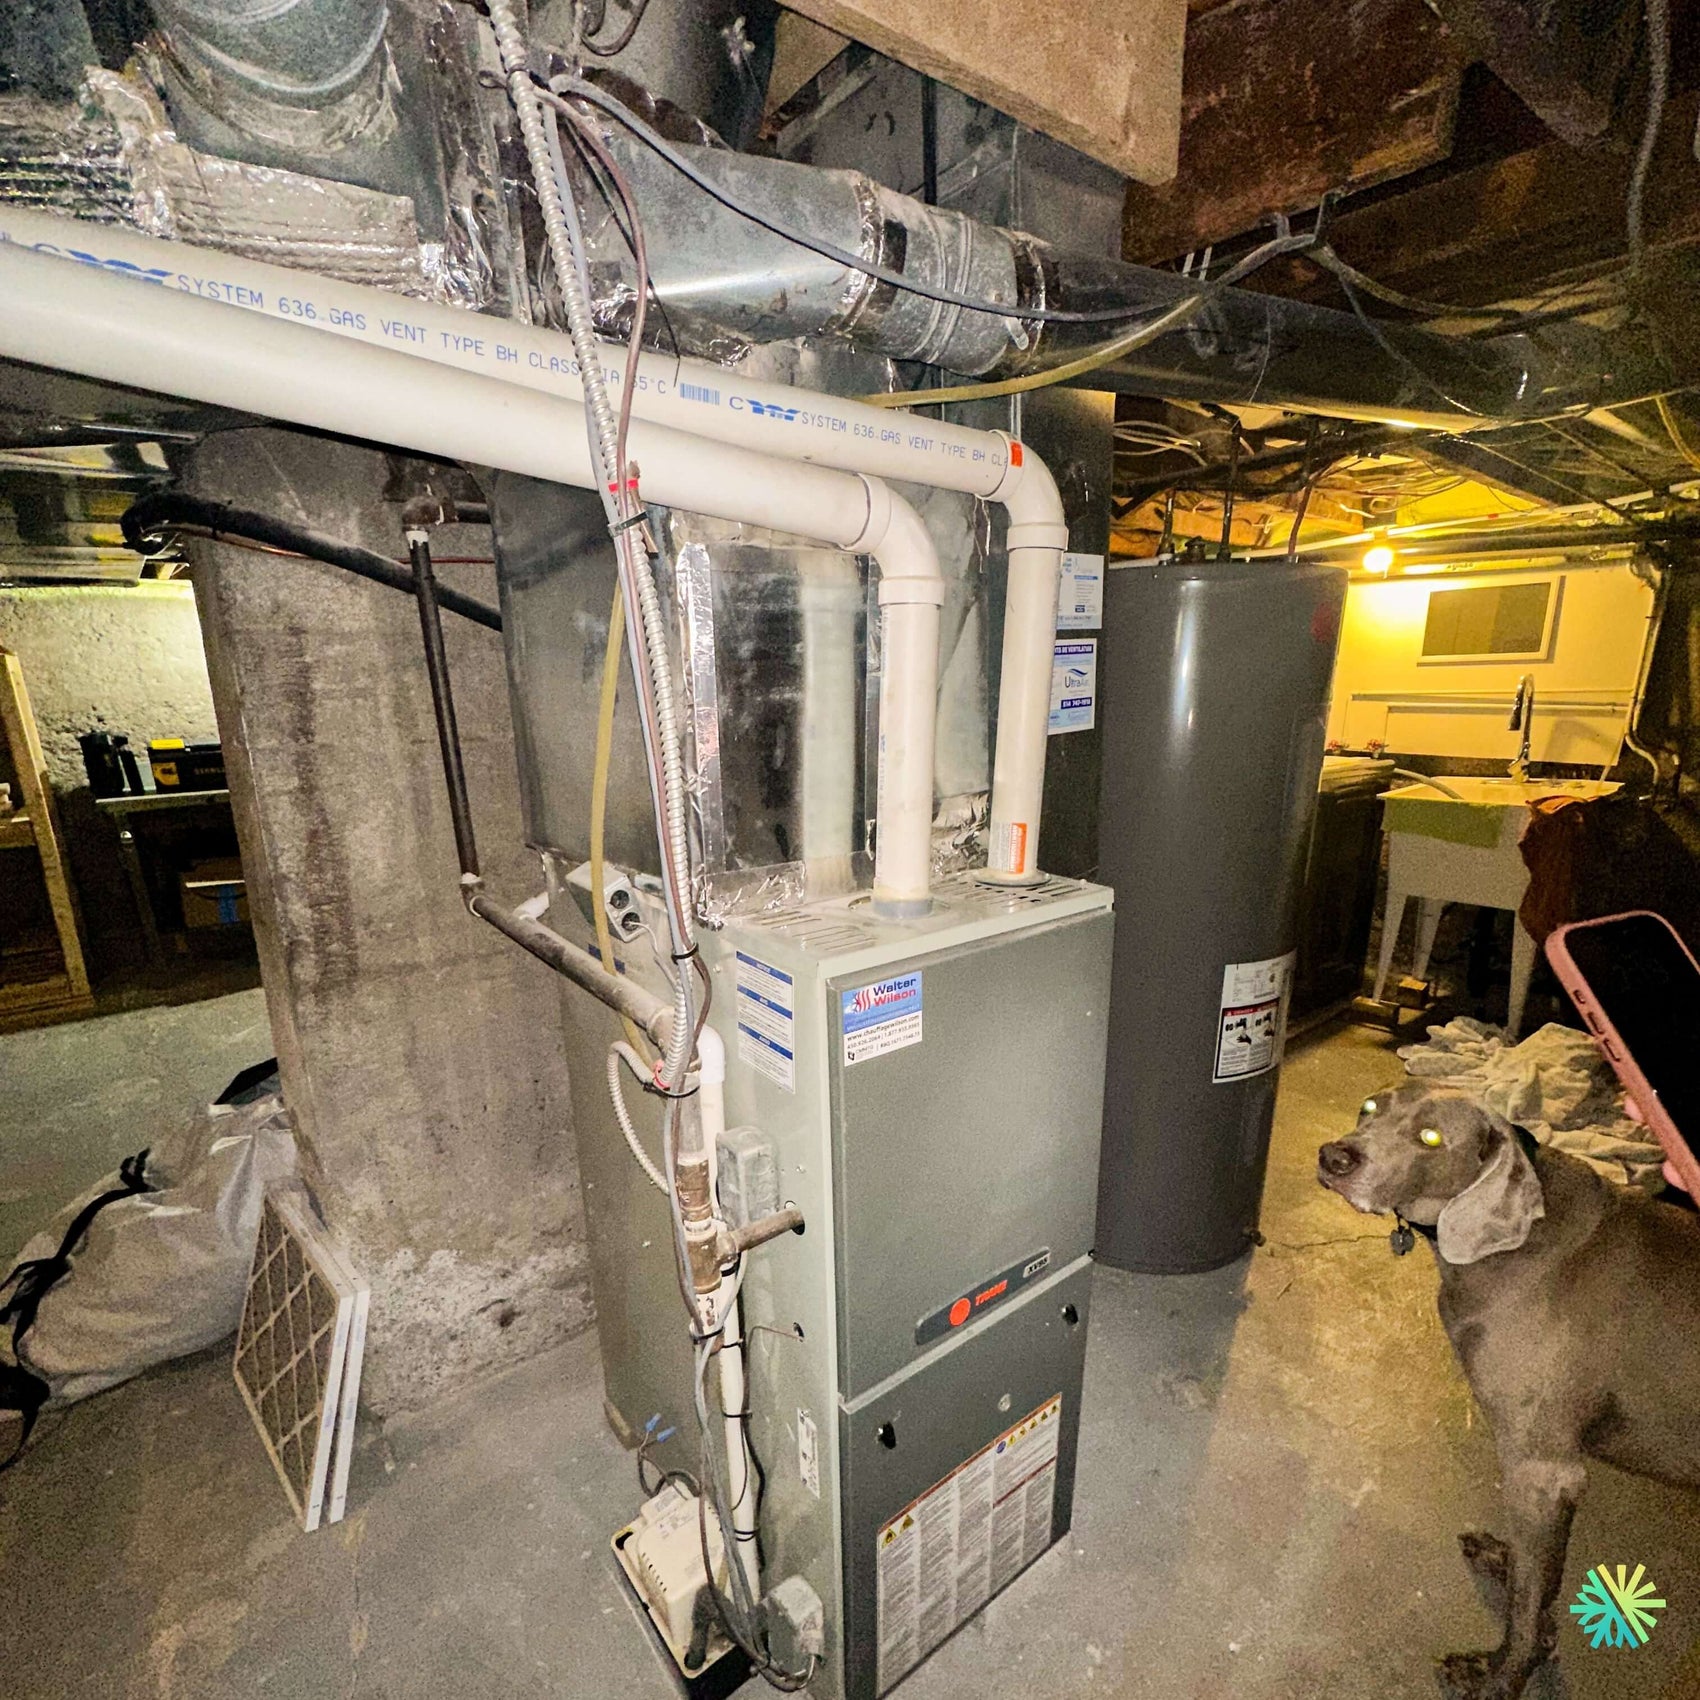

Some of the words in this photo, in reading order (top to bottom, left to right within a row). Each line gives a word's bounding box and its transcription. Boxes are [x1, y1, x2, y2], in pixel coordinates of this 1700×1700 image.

[178, 275, 264, 308] SYSTEM
[380, 319, 427, 344] VENT
[440, 332, 485, 357] TYPE
[496, 345, 518, 364] BH
[529, 352, 580, 376] CLASS
[802, 412, 847, 433] SYSTEM
[908, 435, 934, 452] VENT
[941, 441, 966, 459] TYPE
[972, 449, 985, 463] BH
[873, 978, 917, 996] Walter
[873, 989, 916, 1007] Wilson
[975, 1279, 1008, 1306] TRANE
